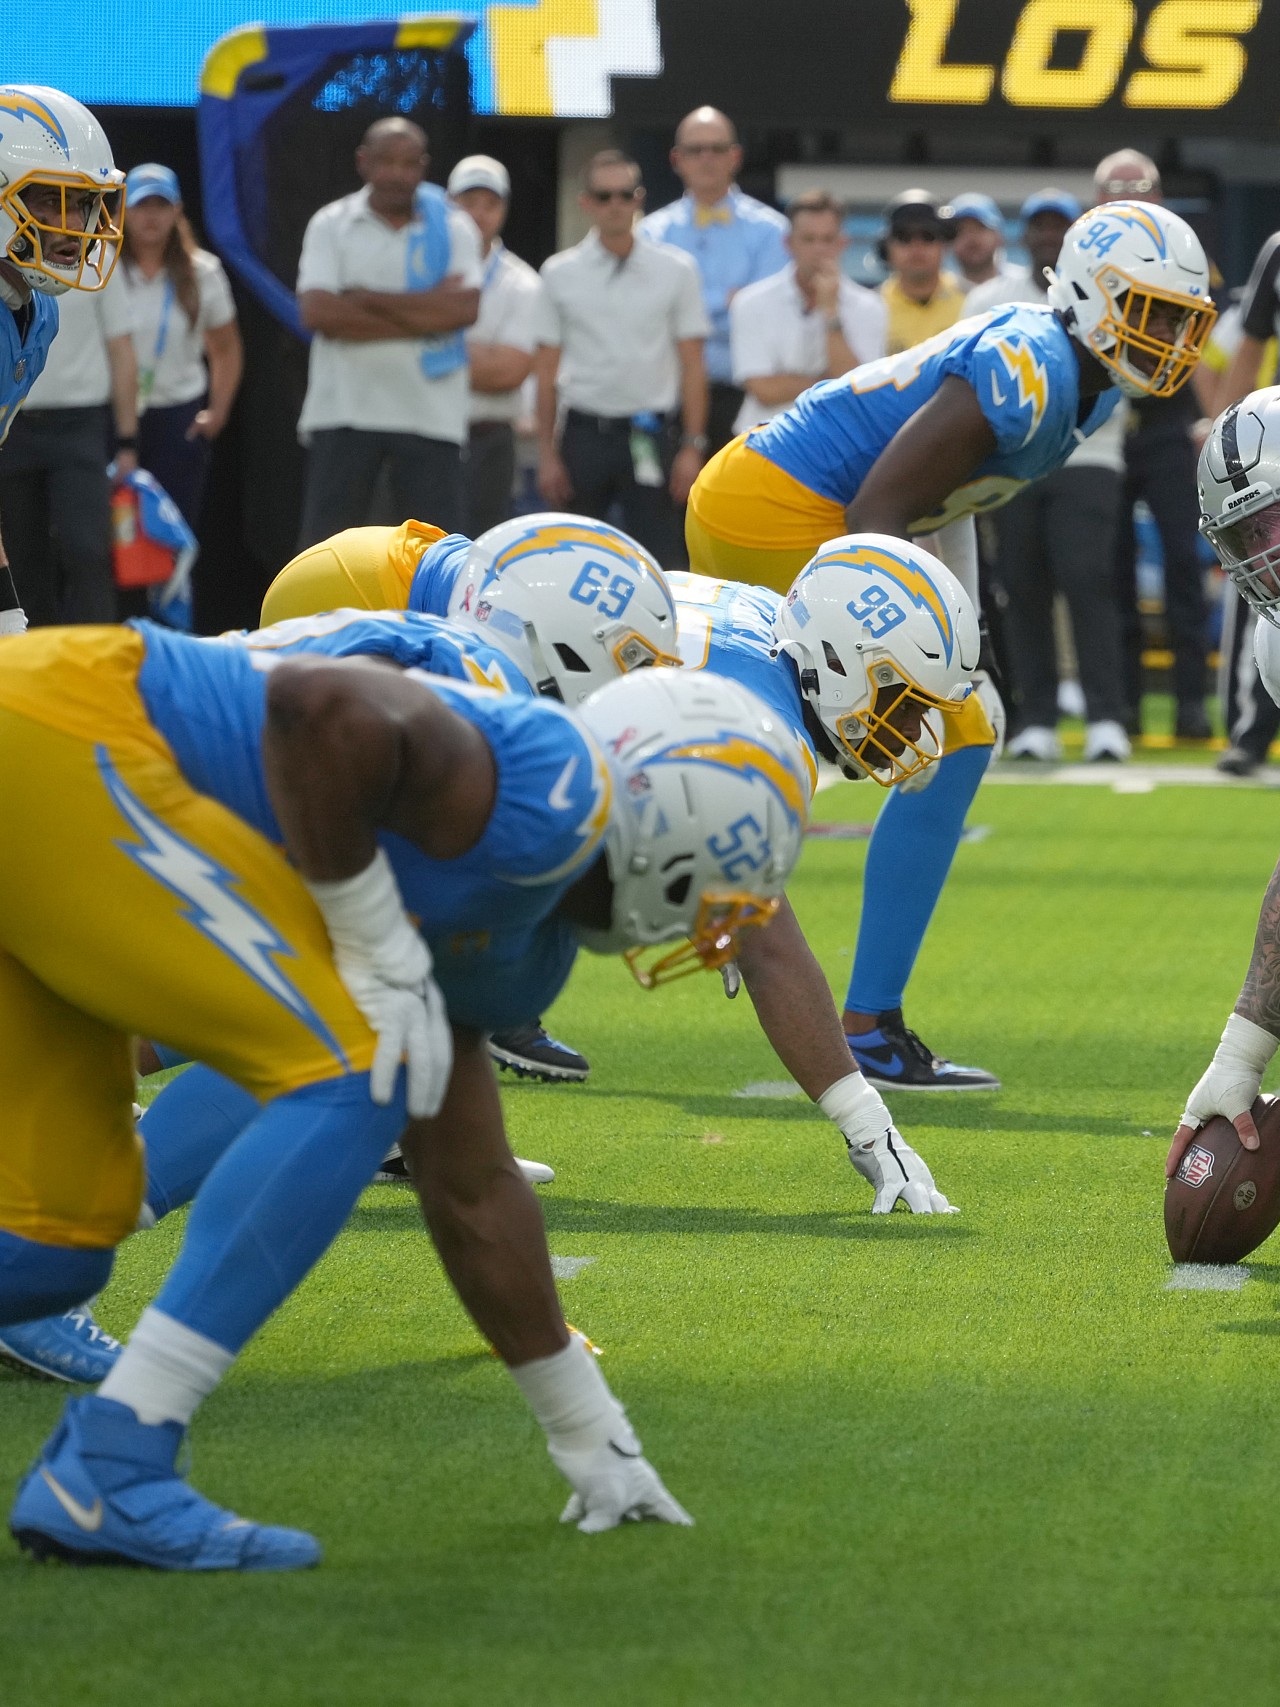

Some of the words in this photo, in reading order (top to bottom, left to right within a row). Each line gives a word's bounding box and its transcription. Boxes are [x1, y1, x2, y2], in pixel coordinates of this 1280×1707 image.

[888, 0, 1261, 109] LOS
[1078, 222, 1123, 258] 94
[1228, 489, 1260, 510] RAIDERS
[569, 560, 635, 620] 69
[847, 585, 906, 638] 99
[706, 813, 772, 883] 52
[1186, 1154, 1210, 1183] NFL
